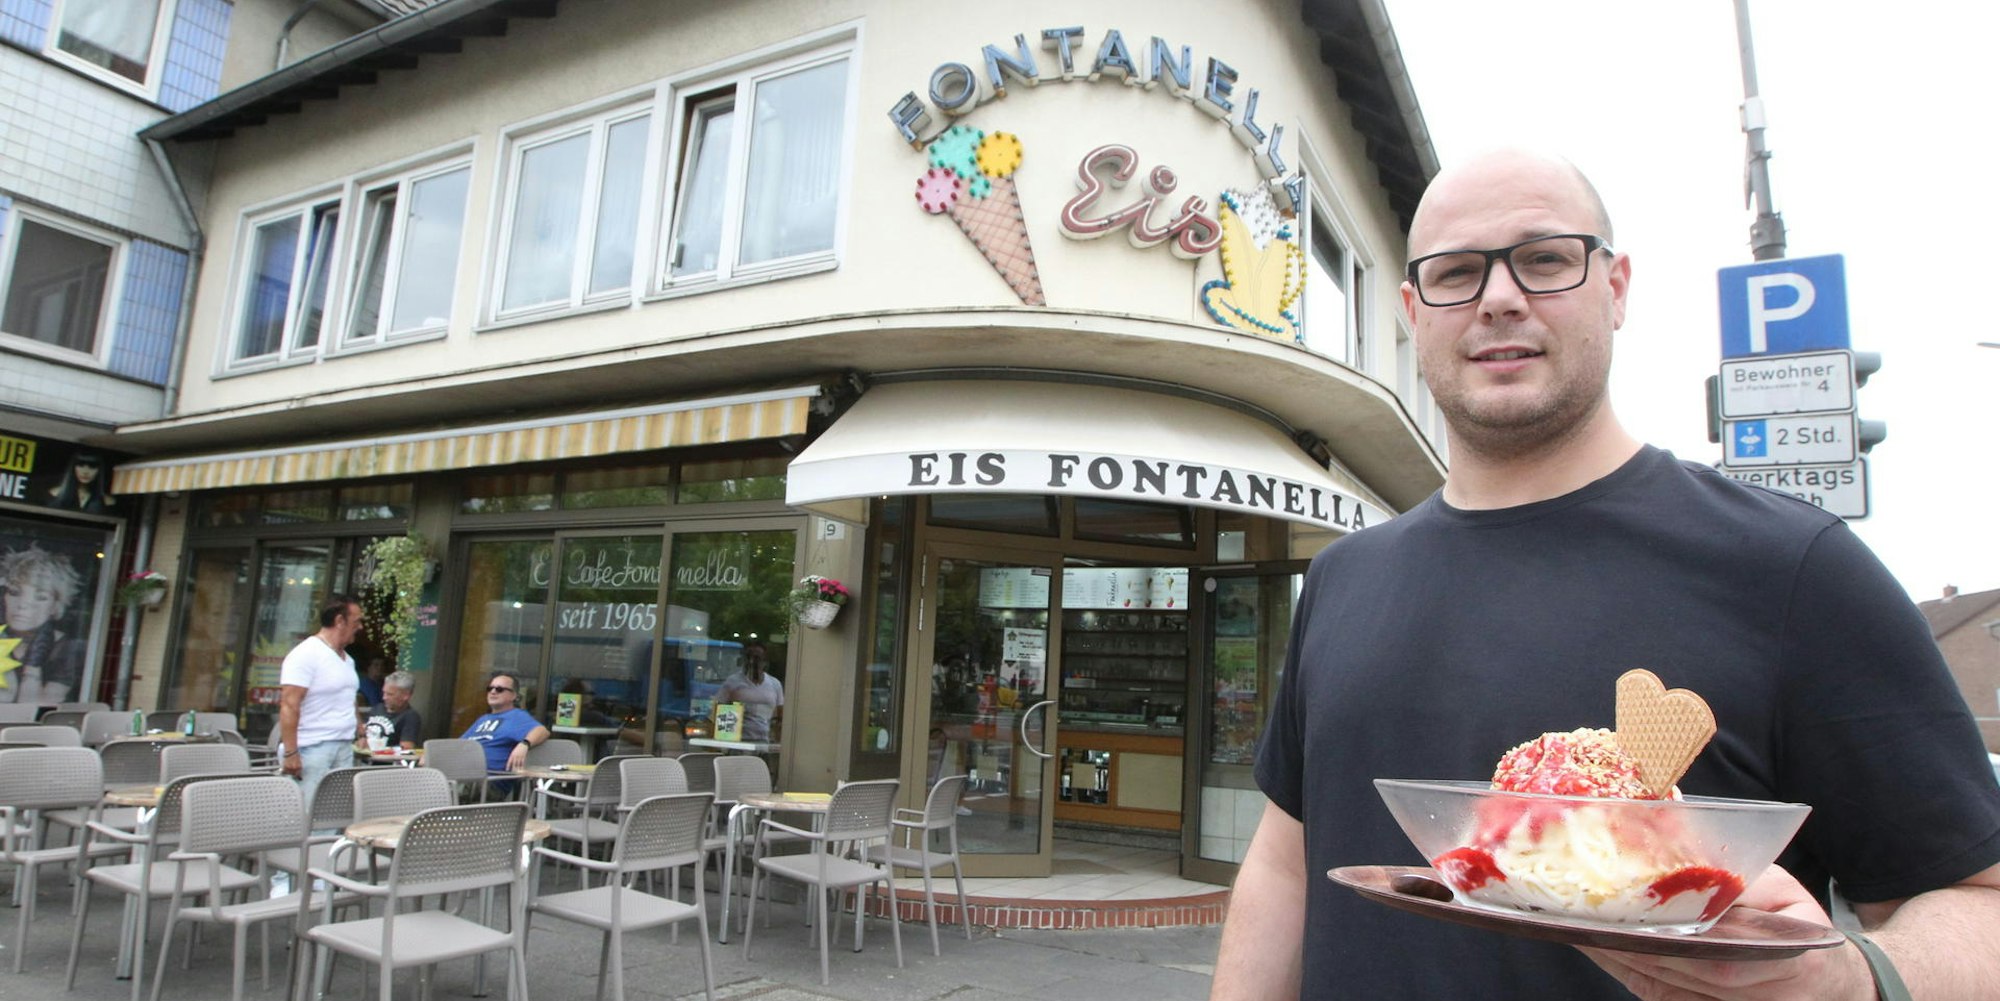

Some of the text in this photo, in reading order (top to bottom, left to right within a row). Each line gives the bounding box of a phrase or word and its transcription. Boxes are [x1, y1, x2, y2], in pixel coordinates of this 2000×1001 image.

[1059, 144, 1222, 259] Eis
[1746, 272, 1816, 353] P
[1734, 365, 1834, 383] Bewohner
[1817, 380, 1829, 393] 4
[1777, 426, 1842, 445] 2 Std.
[0, 473, 28, 499] NE
[908, 452, 1367, 530] EIS FONTANELLA
[827, 524, 835, 535] 9
[611, 548, 743, 587] Fontnella
[559, 602, 659, 632] seit 1965
